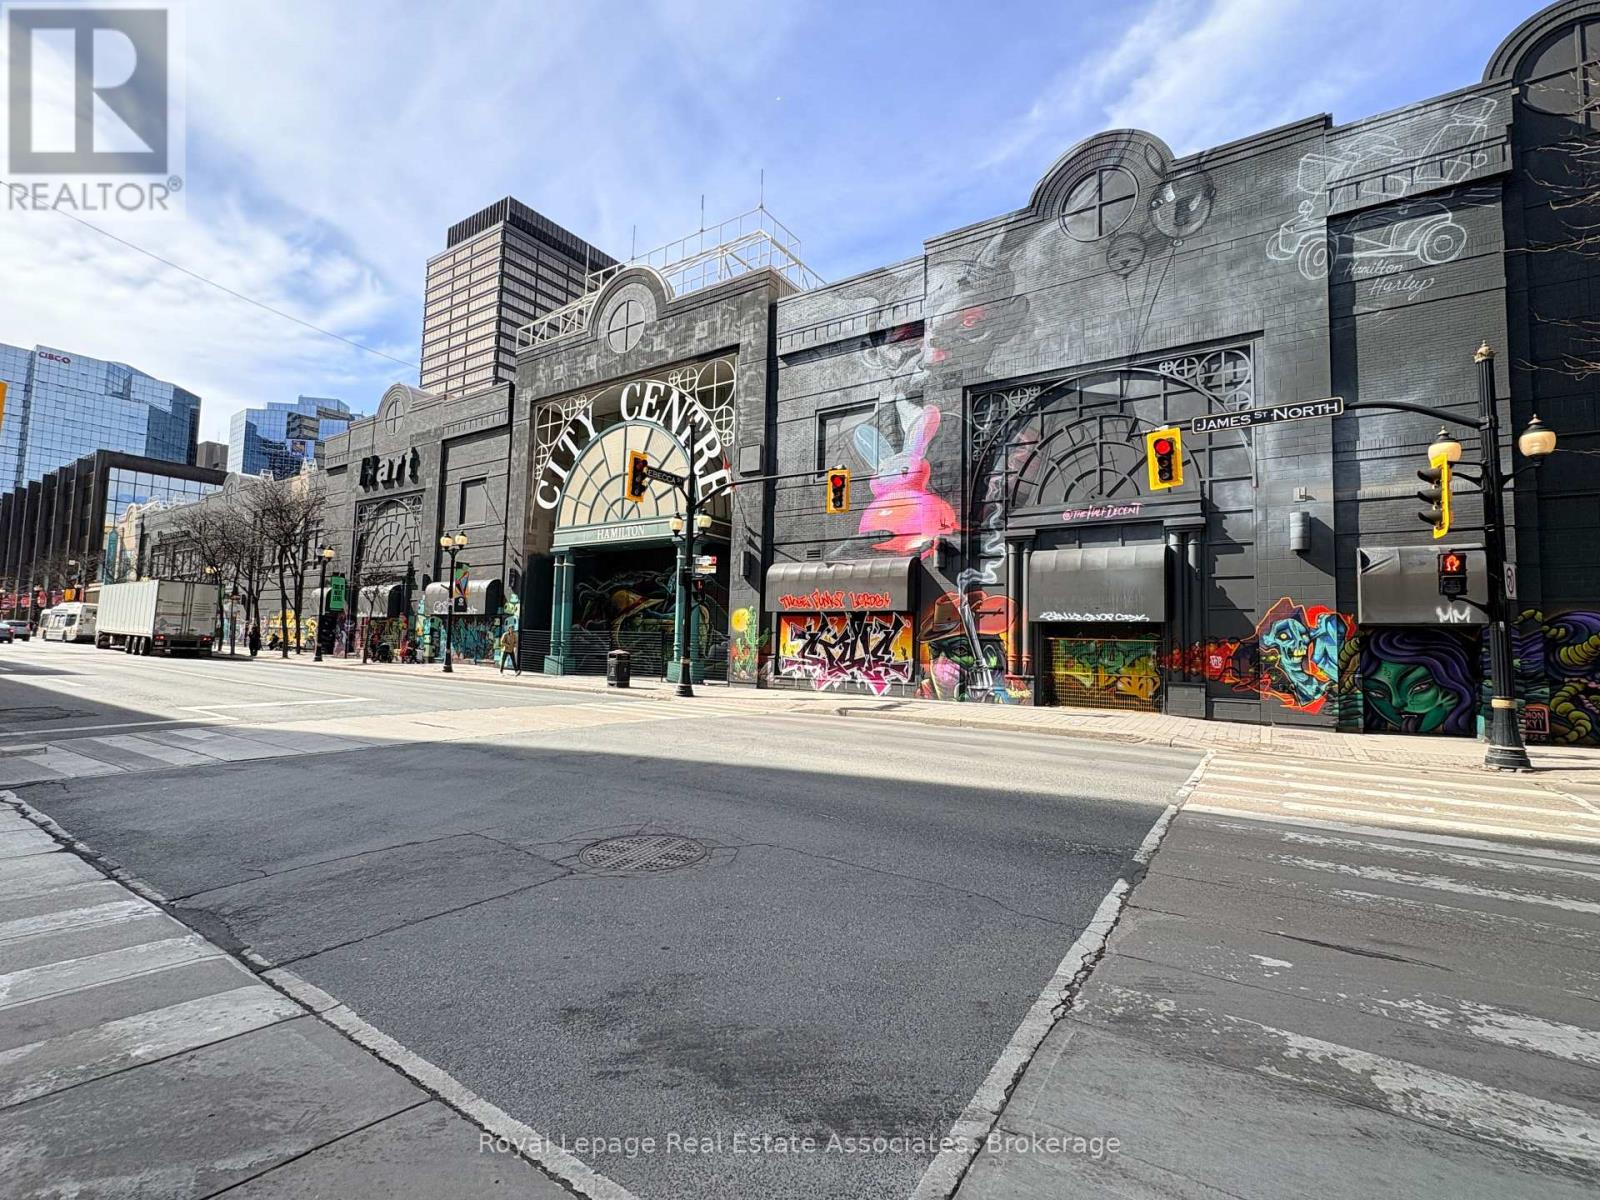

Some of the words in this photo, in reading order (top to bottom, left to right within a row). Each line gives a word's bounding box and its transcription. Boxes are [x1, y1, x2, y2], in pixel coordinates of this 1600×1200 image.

[1344, 259, 1403, 279] Hamilton
[1368, 275, 1434, 301] Harley
[1196, 414, 1251, 431] JAMES
[1254, 411, 1267, 419] ST
[1272, 402, 1338, 421] NORTH
[536, 402, 598, 510] CITY
[620, 382, 732, 503] CENTRE
[359, 447, 420, 492] Hart
[647, 468, 676, 485] EBECCA
[597, 526, 645, 541] HAMILTON
